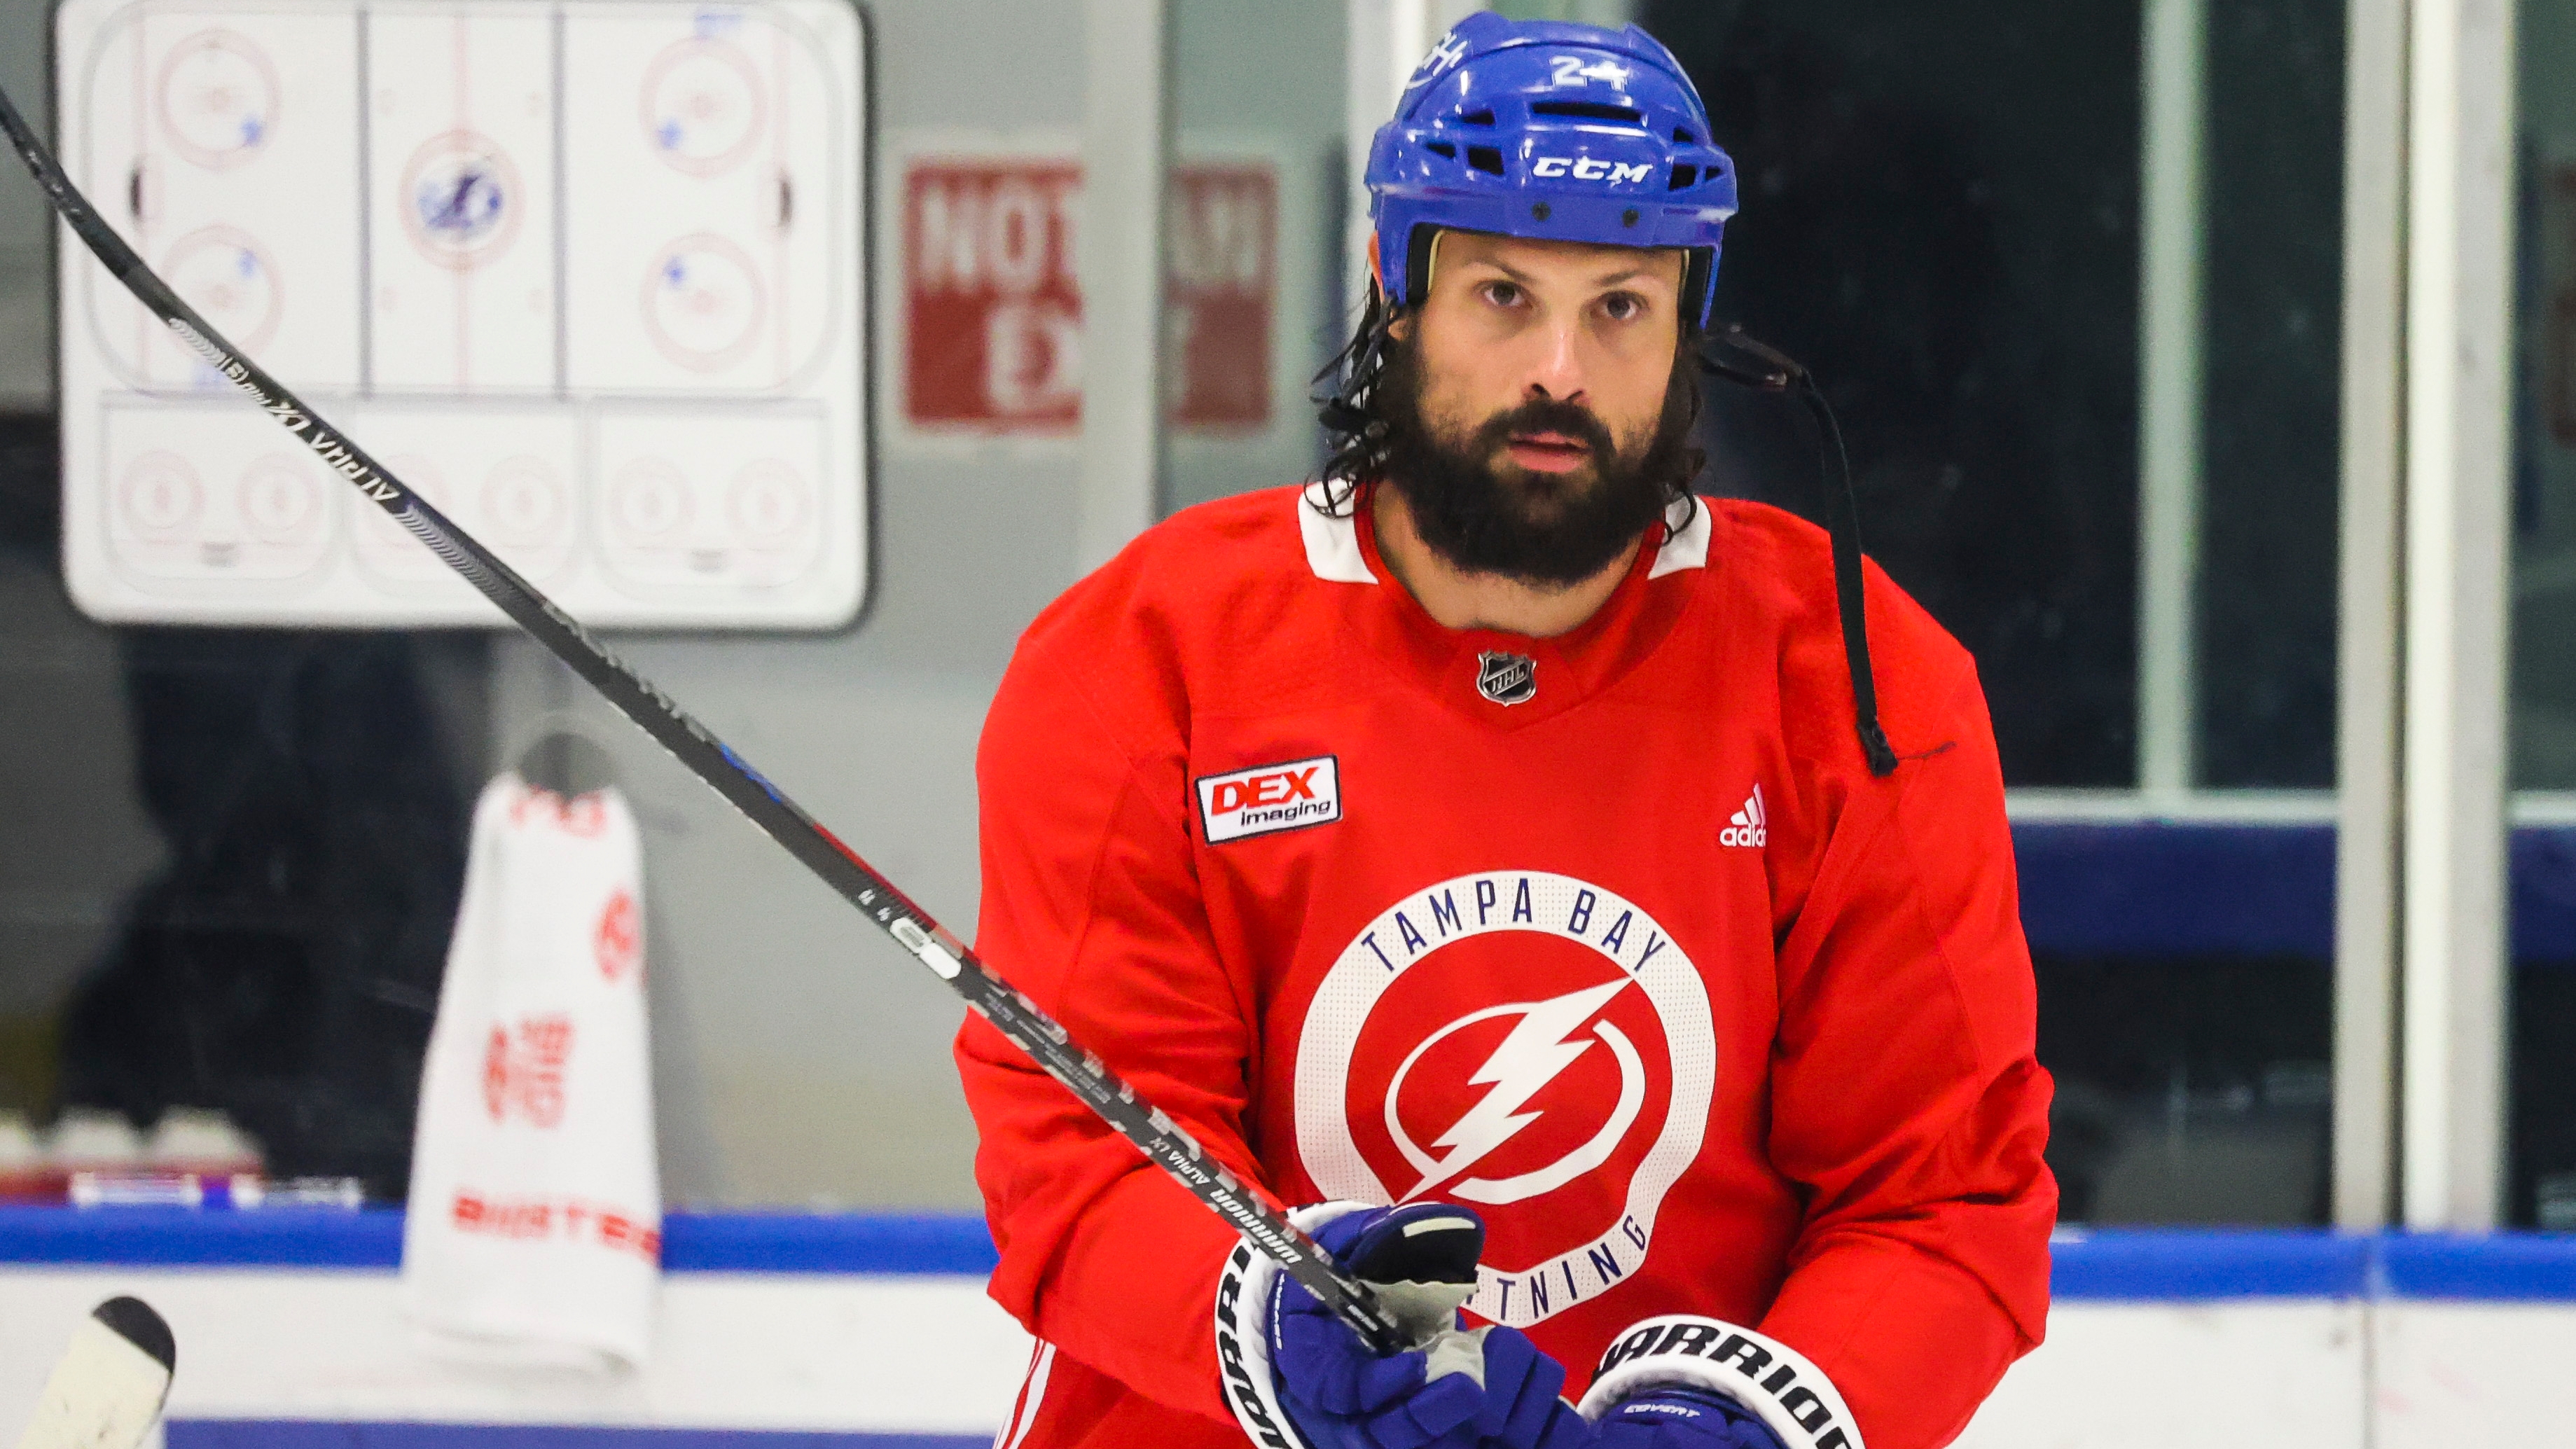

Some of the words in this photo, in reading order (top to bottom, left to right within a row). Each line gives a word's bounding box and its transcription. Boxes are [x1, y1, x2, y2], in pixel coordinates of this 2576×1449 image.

[1533, 155, 1654, 186] CCM
[310, 432, 401, 501] ALPHA
[1492, 665, 1525, 693] NHL
[1212, 767, 1320, 816] DEX
[1240, 800, 1331, 826] imaging
[1361, 878, 1532, 971] TAMPA
[1567, 889, 1666, 972] BAY
[1168, 1150, 1210, 1184] ALPHA
[1210, 1189, 1303, 1263] WARRIOR
[1466, 1214, 1645, 1321] TNING
